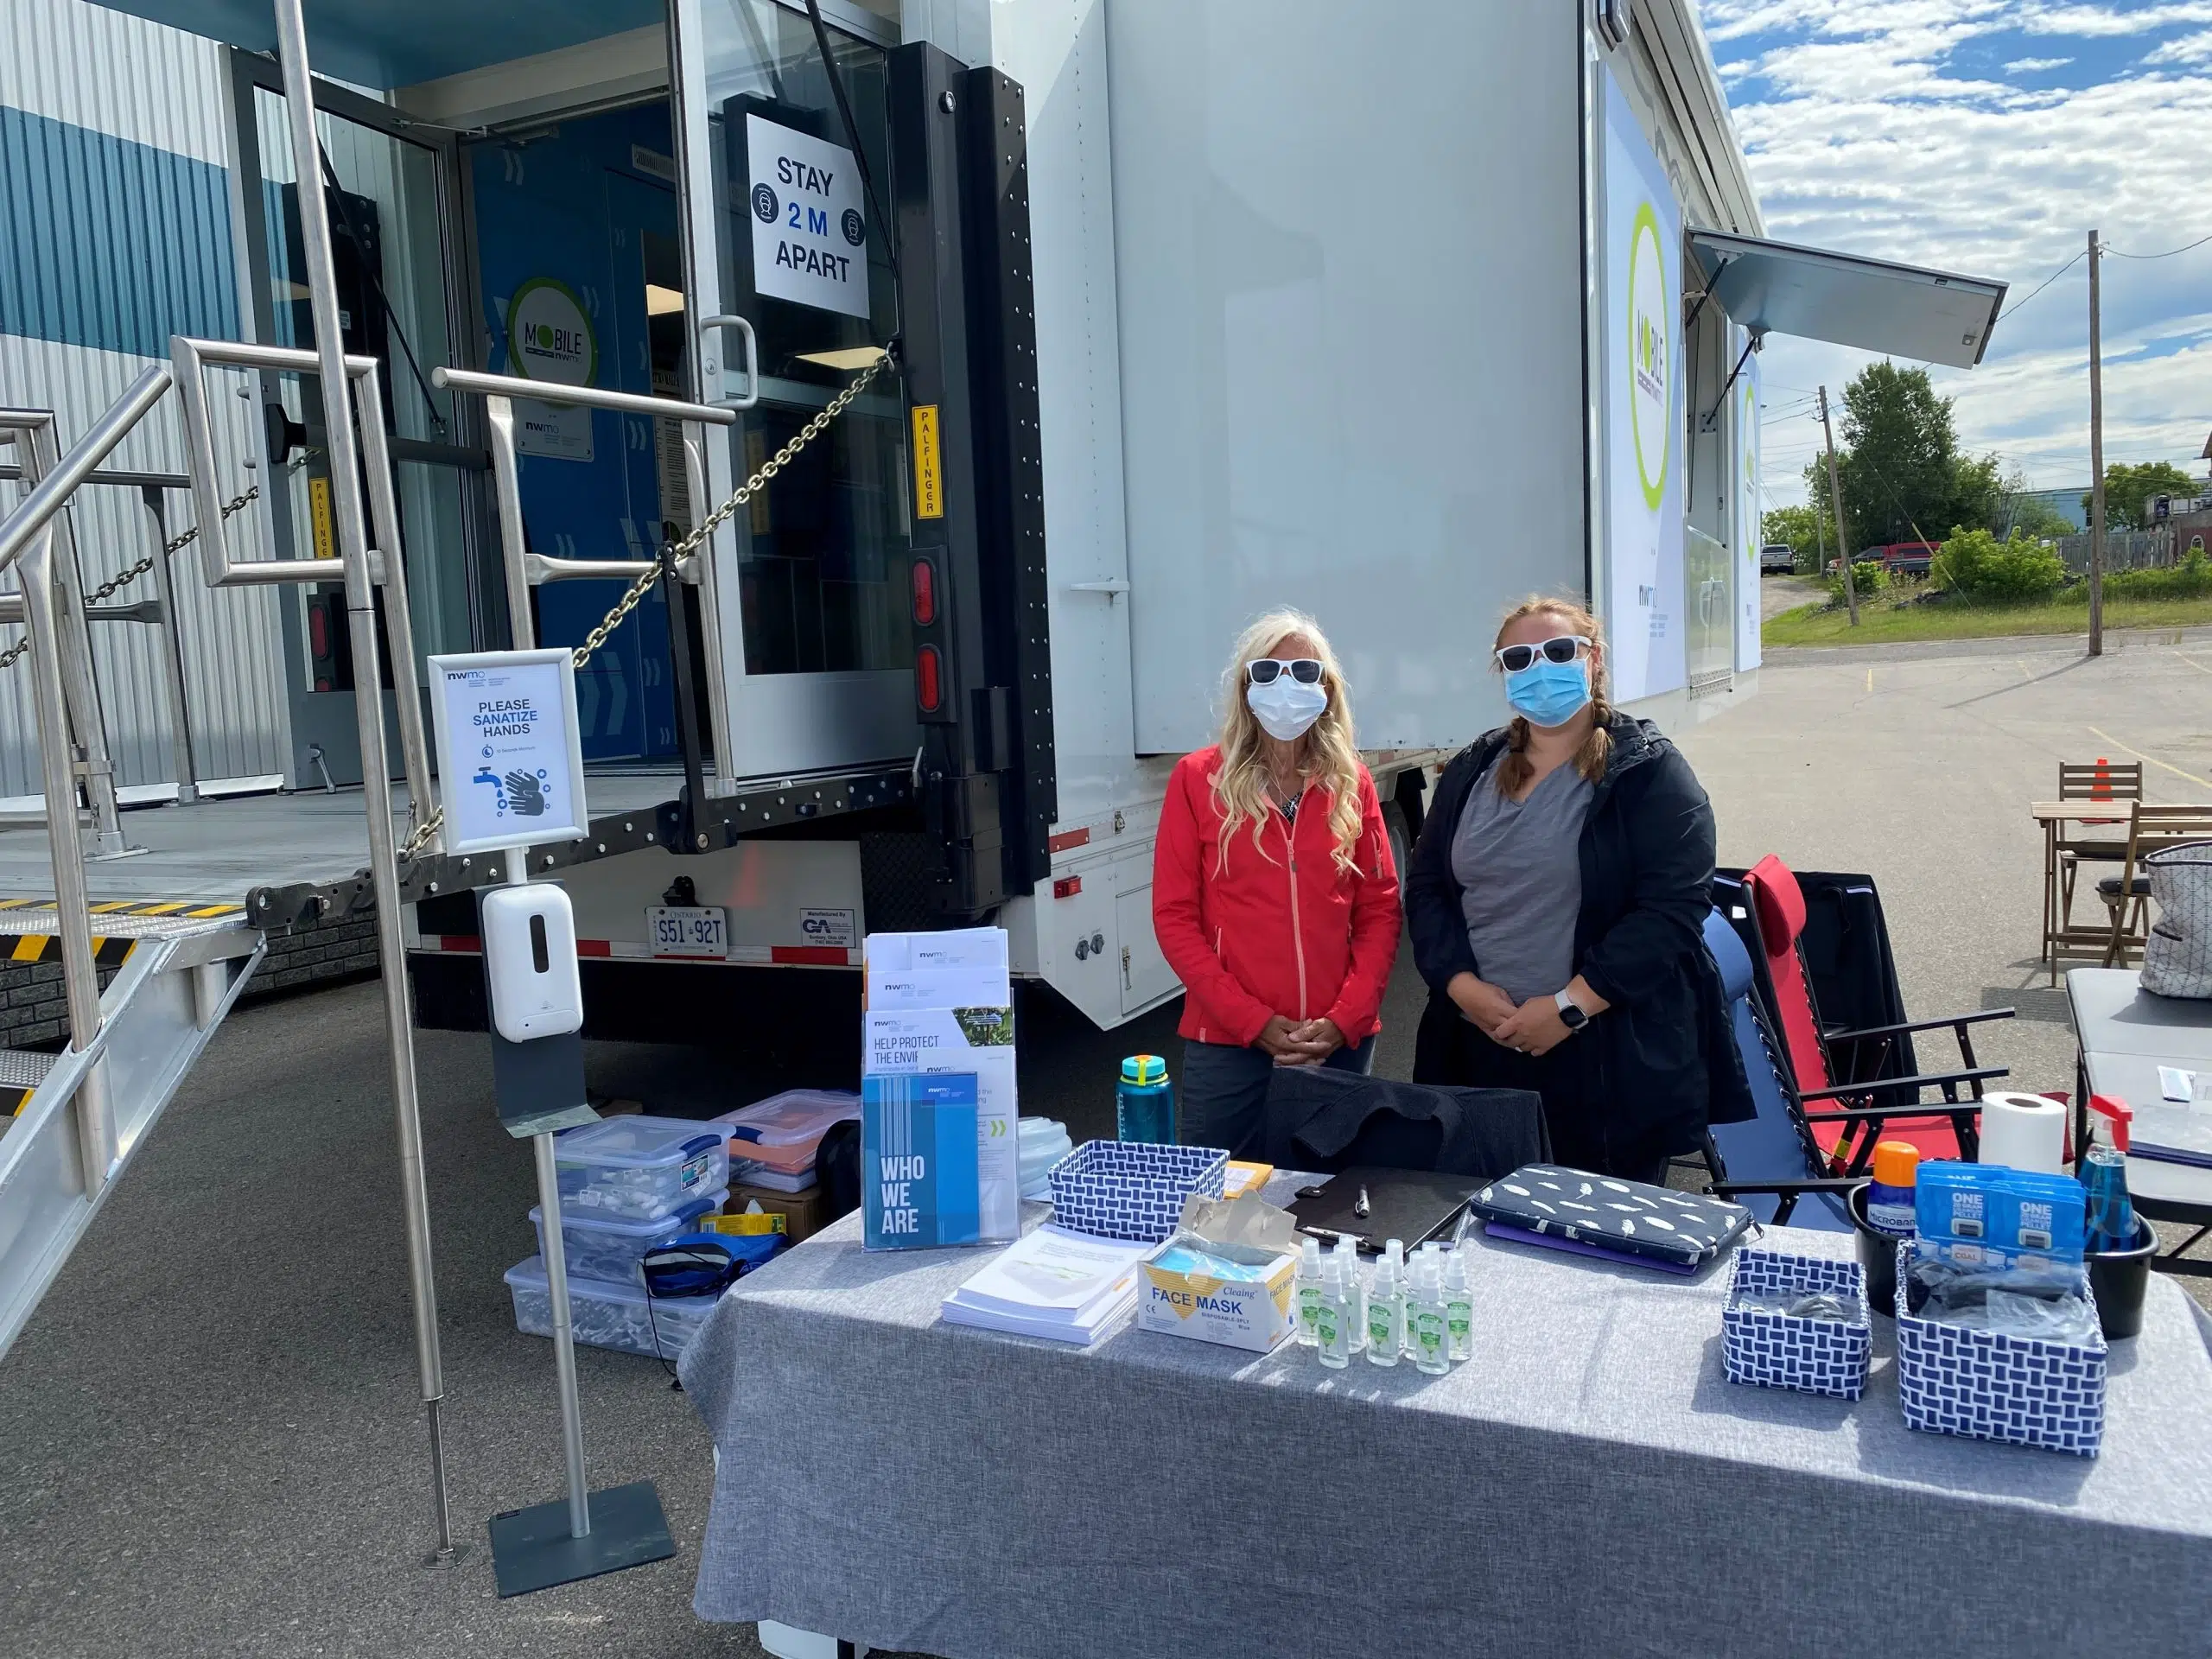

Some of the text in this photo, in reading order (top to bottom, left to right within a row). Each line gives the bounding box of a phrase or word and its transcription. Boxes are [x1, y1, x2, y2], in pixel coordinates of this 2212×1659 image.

[777, 156, 834, 197] STAY
[788, 201, 829, 237] 2 M
[775, 240, 849, 283] APART
[525, 421, 560, 434] nwmo
[921, 411, 934, 512] PALFINGER
[315, 483, 328, 557] PALFINGE
[448, 671, 486, 681] nwmo
[479, 698, 531, 713] PLEASE
[473, 710, 538, 726] SANATIZE
[483, 723, 531, 737] HANDS
[659, 919, 721, 944] S51 92T
[874, 1035, 939, 1050] HELP PROTECT
[874, 1052, 892, 1064] THE
[880, 1154, 925, 1182] WHO
[880, 1182, 911, 1208] WE
[1952, 1192, 1984, 1205] ONE
[2020, 1202, 2053, 1215] ONE
[881, 1208, 919, 1235] ARE
[1869, 1210, 1916, 1226] MICROBAN
[1152, 1287, 1243, 1315] FACE MASK
[1269, 1287, 1283, 1300] FACE
